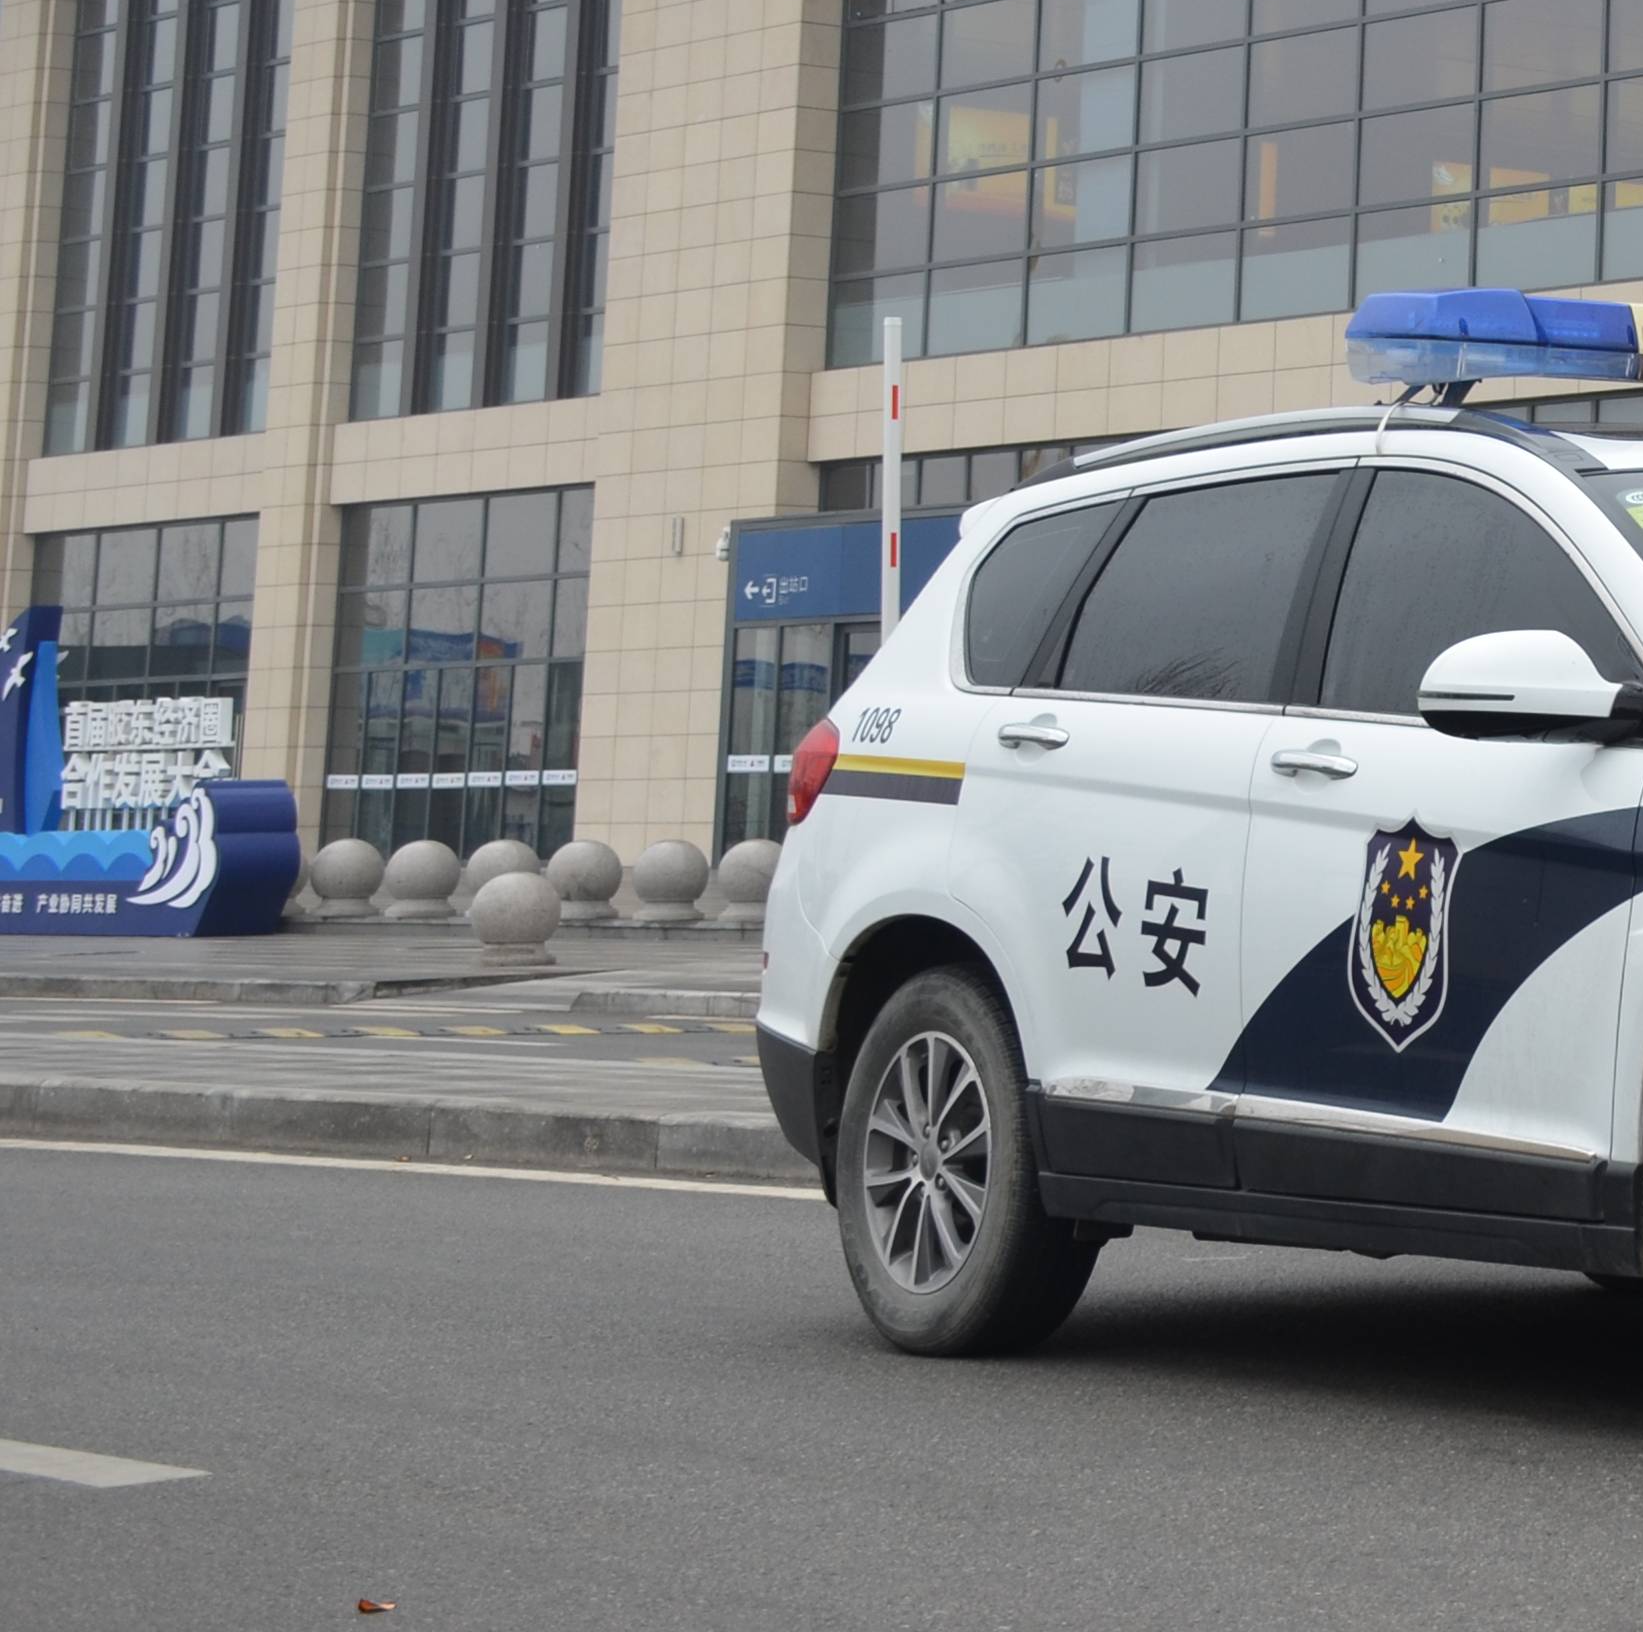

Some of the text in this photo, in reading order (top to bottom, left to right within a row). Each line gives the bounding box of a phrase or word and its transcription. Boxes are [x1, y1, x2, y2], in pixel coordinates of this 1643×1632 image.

[64, 698, 232, 748] 首届胶东经济圈
[852, 706, 902, 744] 1098
[36, 893, 118, 914] 产业协同共发展
[1062, 856, 1209, 998] 公安
